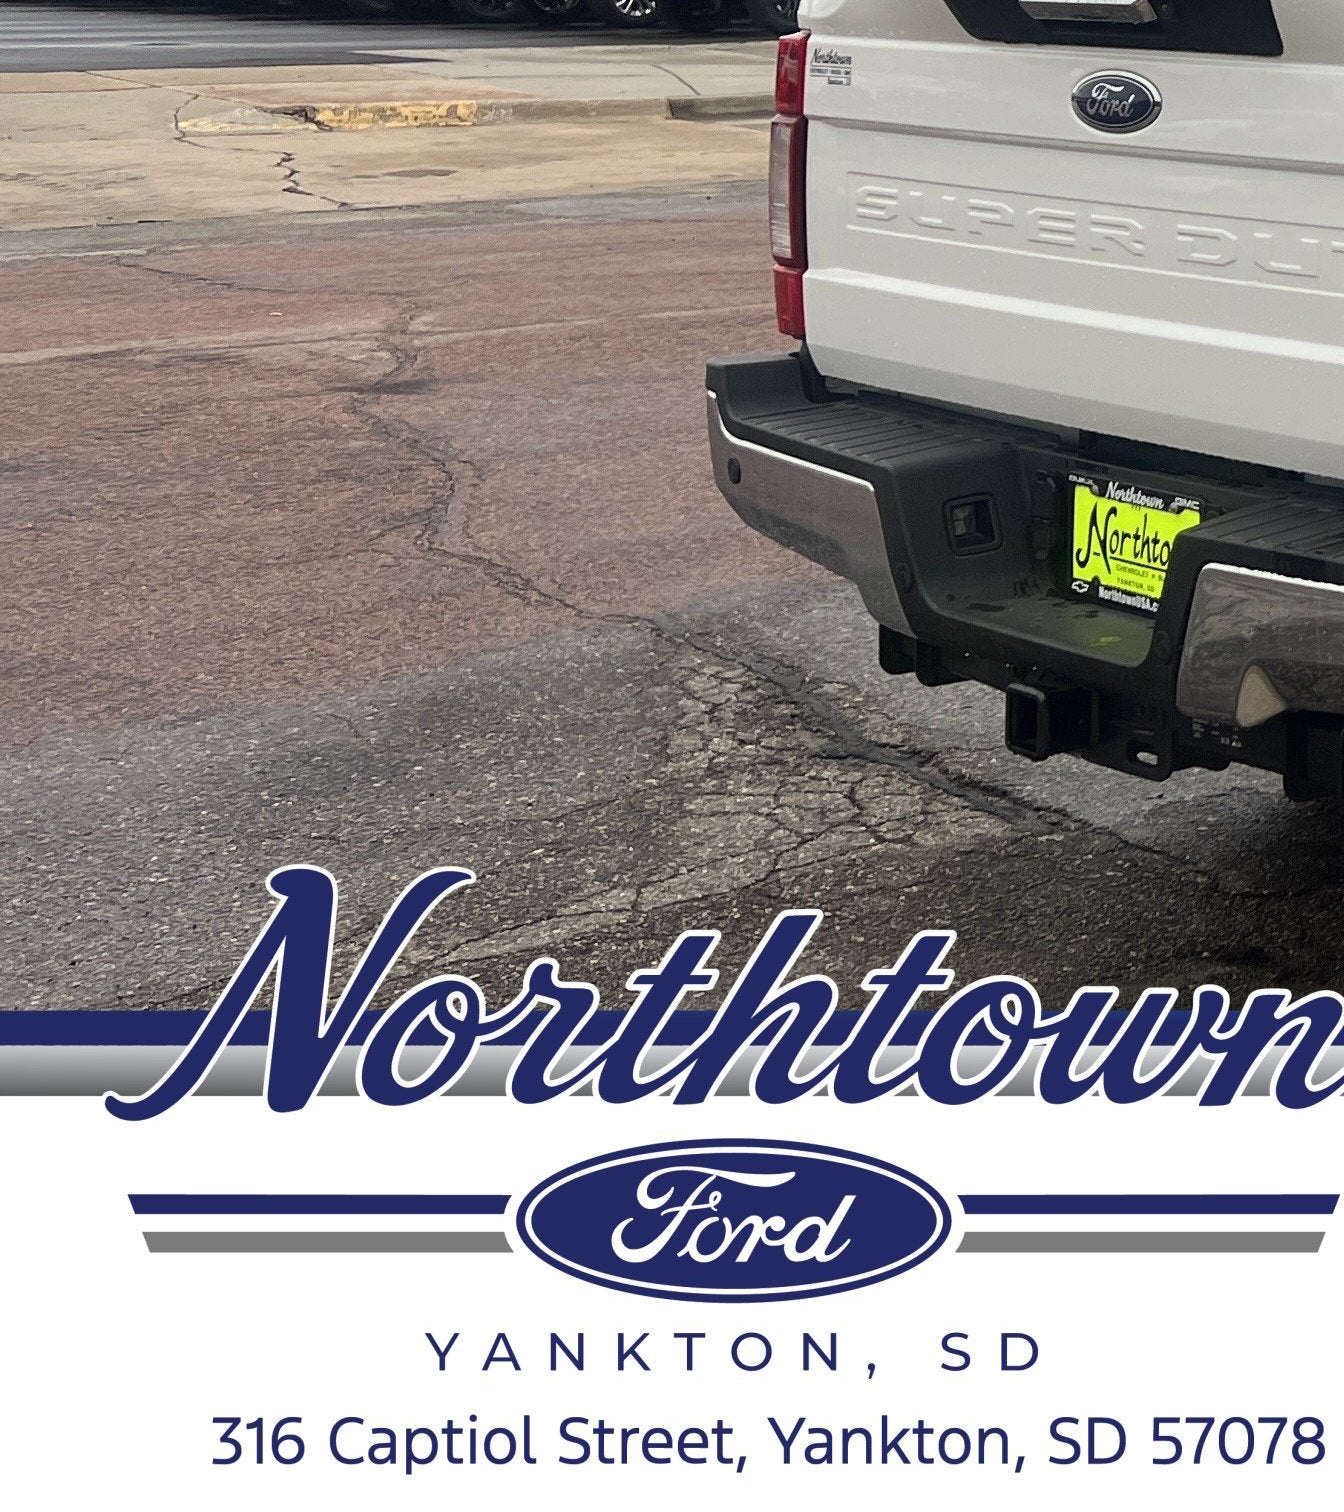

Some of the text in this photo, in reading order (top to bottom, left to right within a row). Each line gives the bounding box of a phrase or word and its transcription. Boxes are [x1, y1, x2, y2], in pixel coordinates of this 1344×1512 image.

[1086, 83, 1135, 118] Ford
[857, 186, 1144, 257] SUPER
[1105, 481, 1165, 509] Northtown
